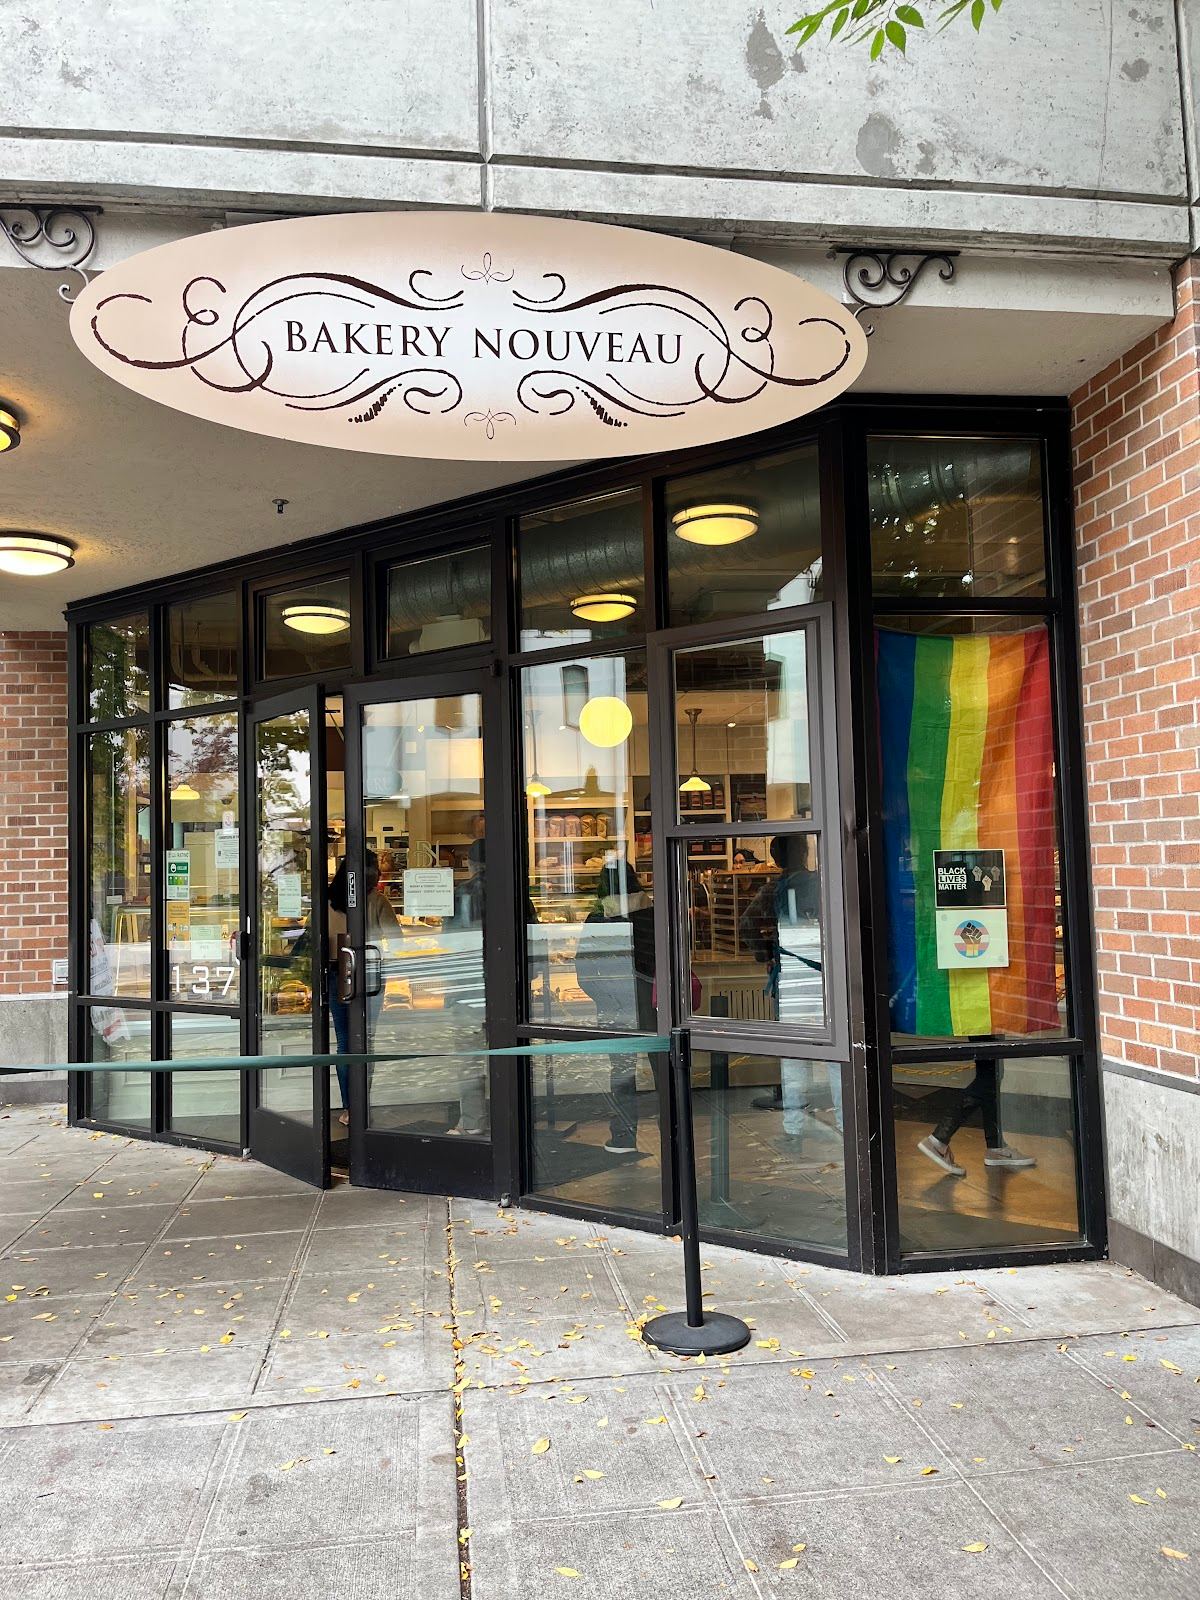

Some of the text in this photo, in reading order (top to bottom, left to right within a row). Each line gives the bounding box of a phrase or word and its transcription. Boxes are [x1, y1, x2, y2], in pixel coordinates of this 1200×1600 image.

[284, 319, 683, 364] BAKERY NOUVEAU
[937, 867, 966, 875] BLACK
[939, 875, 966, 883] LIVES
[171, 965, 235, 996] 137
